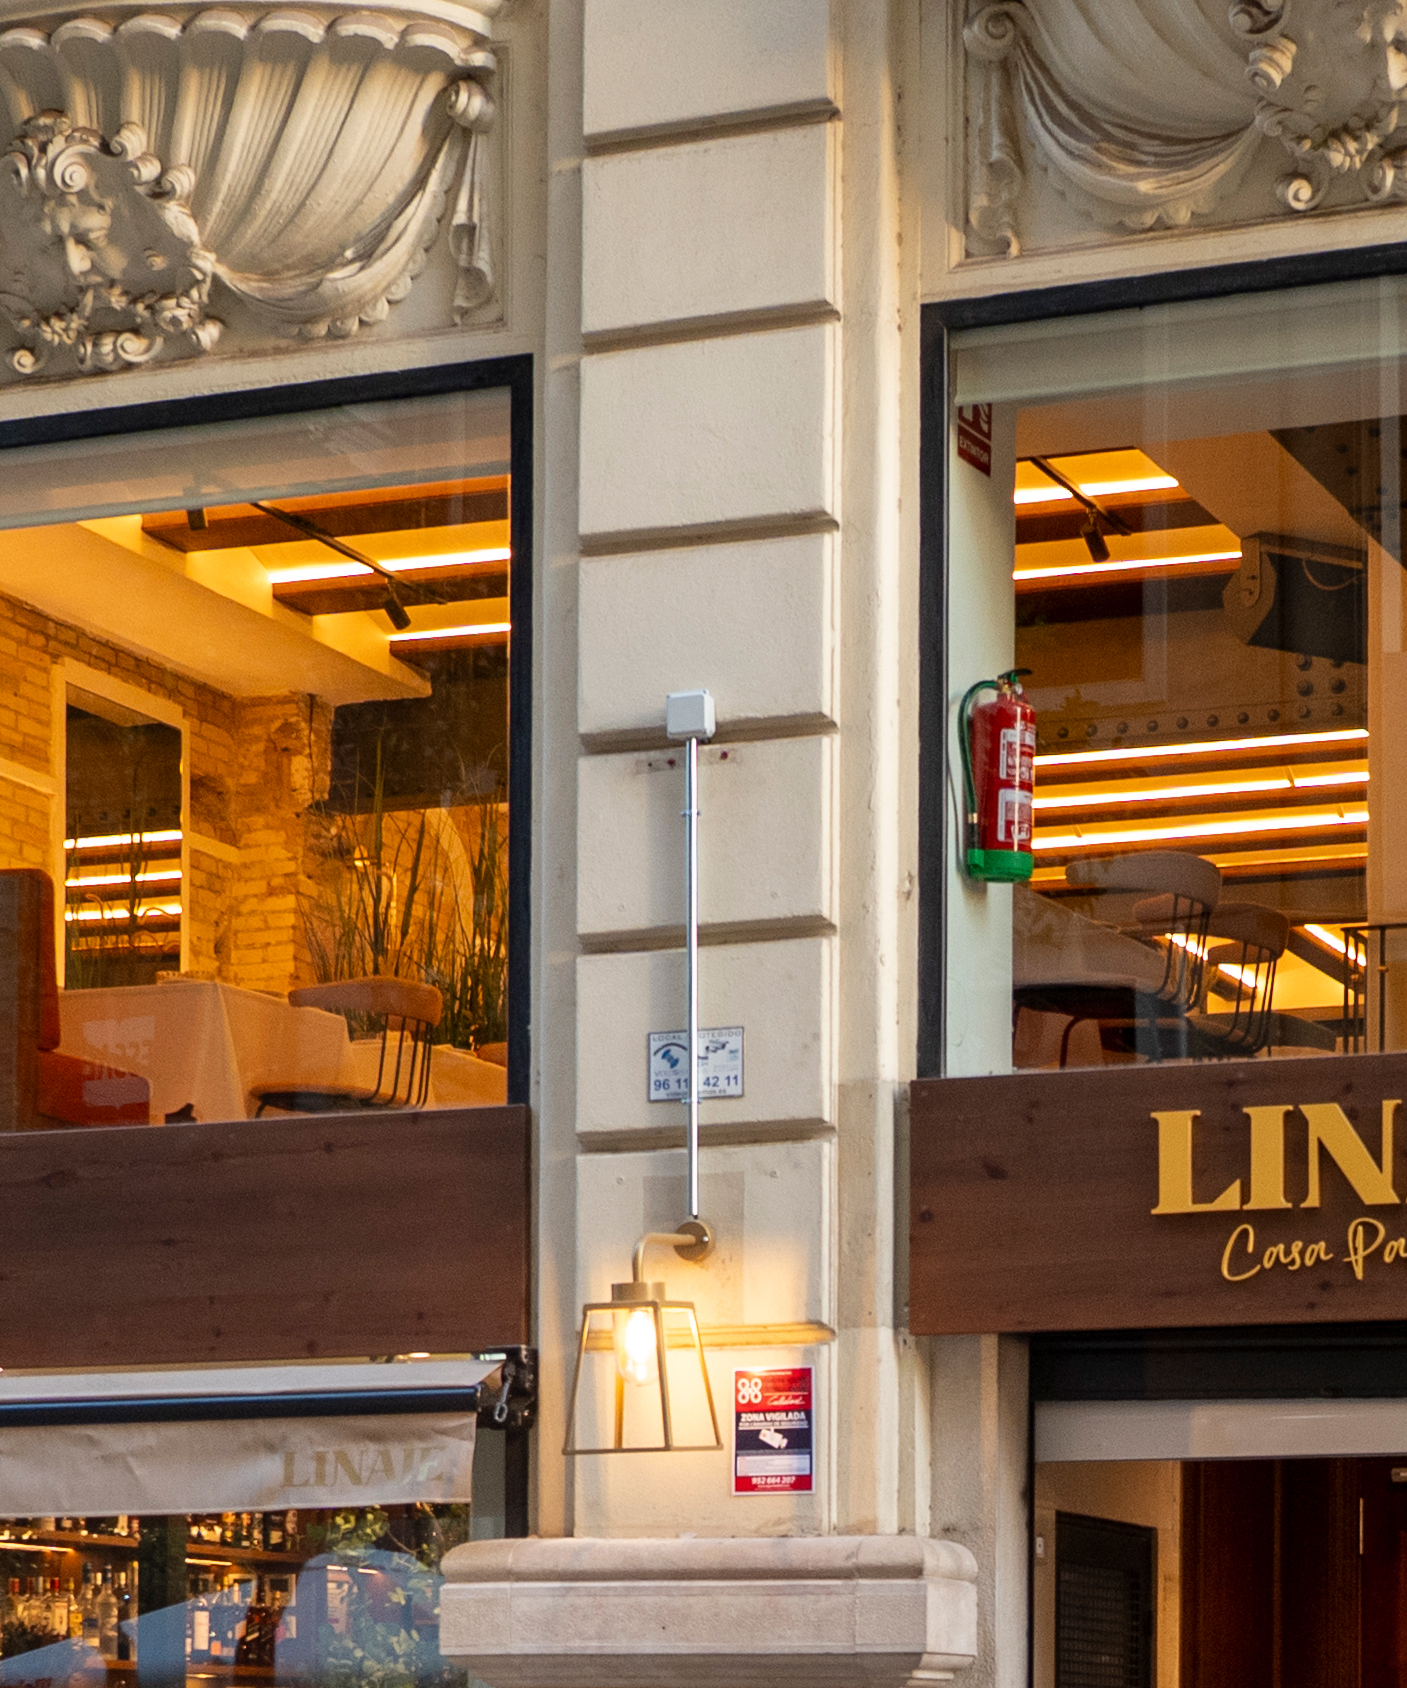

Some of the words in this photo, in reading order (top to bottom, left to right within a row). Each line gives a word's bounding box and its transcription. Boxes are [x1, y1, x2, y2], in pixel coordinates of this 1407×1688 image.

[698, 1030, 741, 1039] OTEGIDO
[654, 1078, 670, 1091] 96
[676, 1077, 690, 1090] 11
[703, 1076, 720, 1088] 42
[725, 1074, 739, 1087] 11
[1220, 1223, 1333, 1282] Casa
[740, 1412, 765, 1422] ZONA
[765, 1411, 806, 1421] VIGILADA
[281, 1444, 445, 1488] LINAJE
